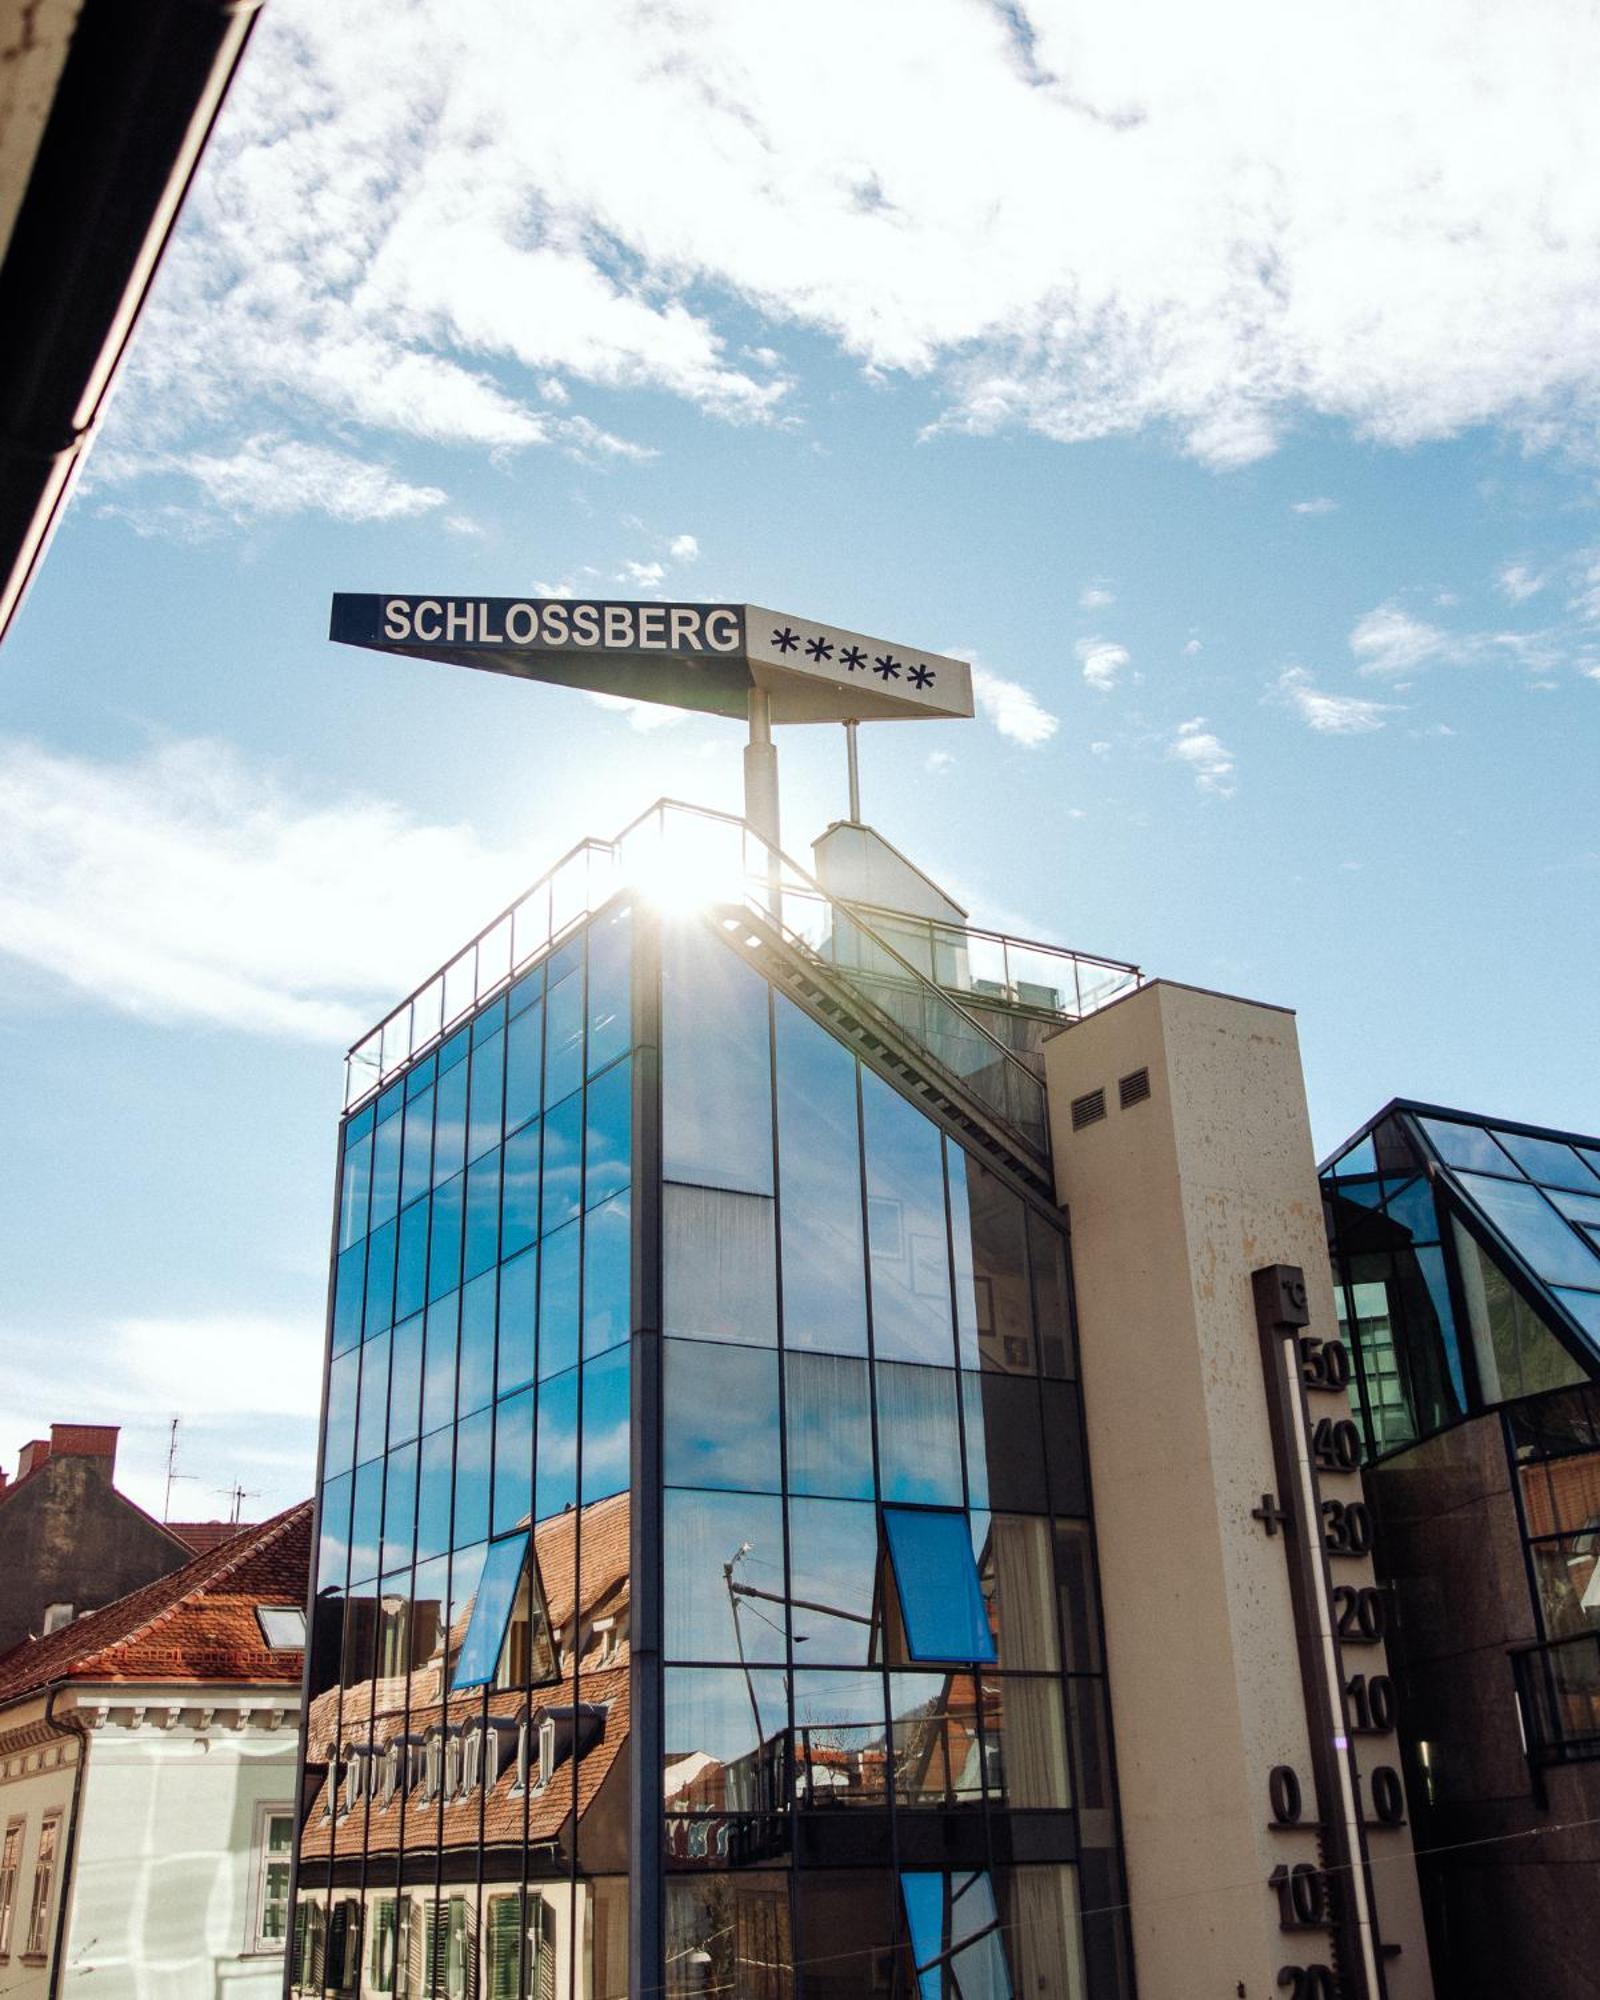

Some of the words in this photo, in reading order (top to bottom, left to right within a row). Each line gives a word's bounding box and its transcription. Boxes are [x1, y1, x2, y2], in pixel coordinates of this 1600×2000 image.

[383, 599, 741, 652] SCHLOSSBERG
[1300, 1337, 1350, 1386] 50
[1314, 1418, 1361, 1467] 40
[1322, 1500, 1374, 1552] 30
[1333, 1585, 1384, 1637] 20
[1345, 1674, 1396, 1729] 10
[1269, 1765, 1301, 1824] 0
[1371, 1766, 1403, 1822] 0
[1269, 1863, 1324, 1924] 10
